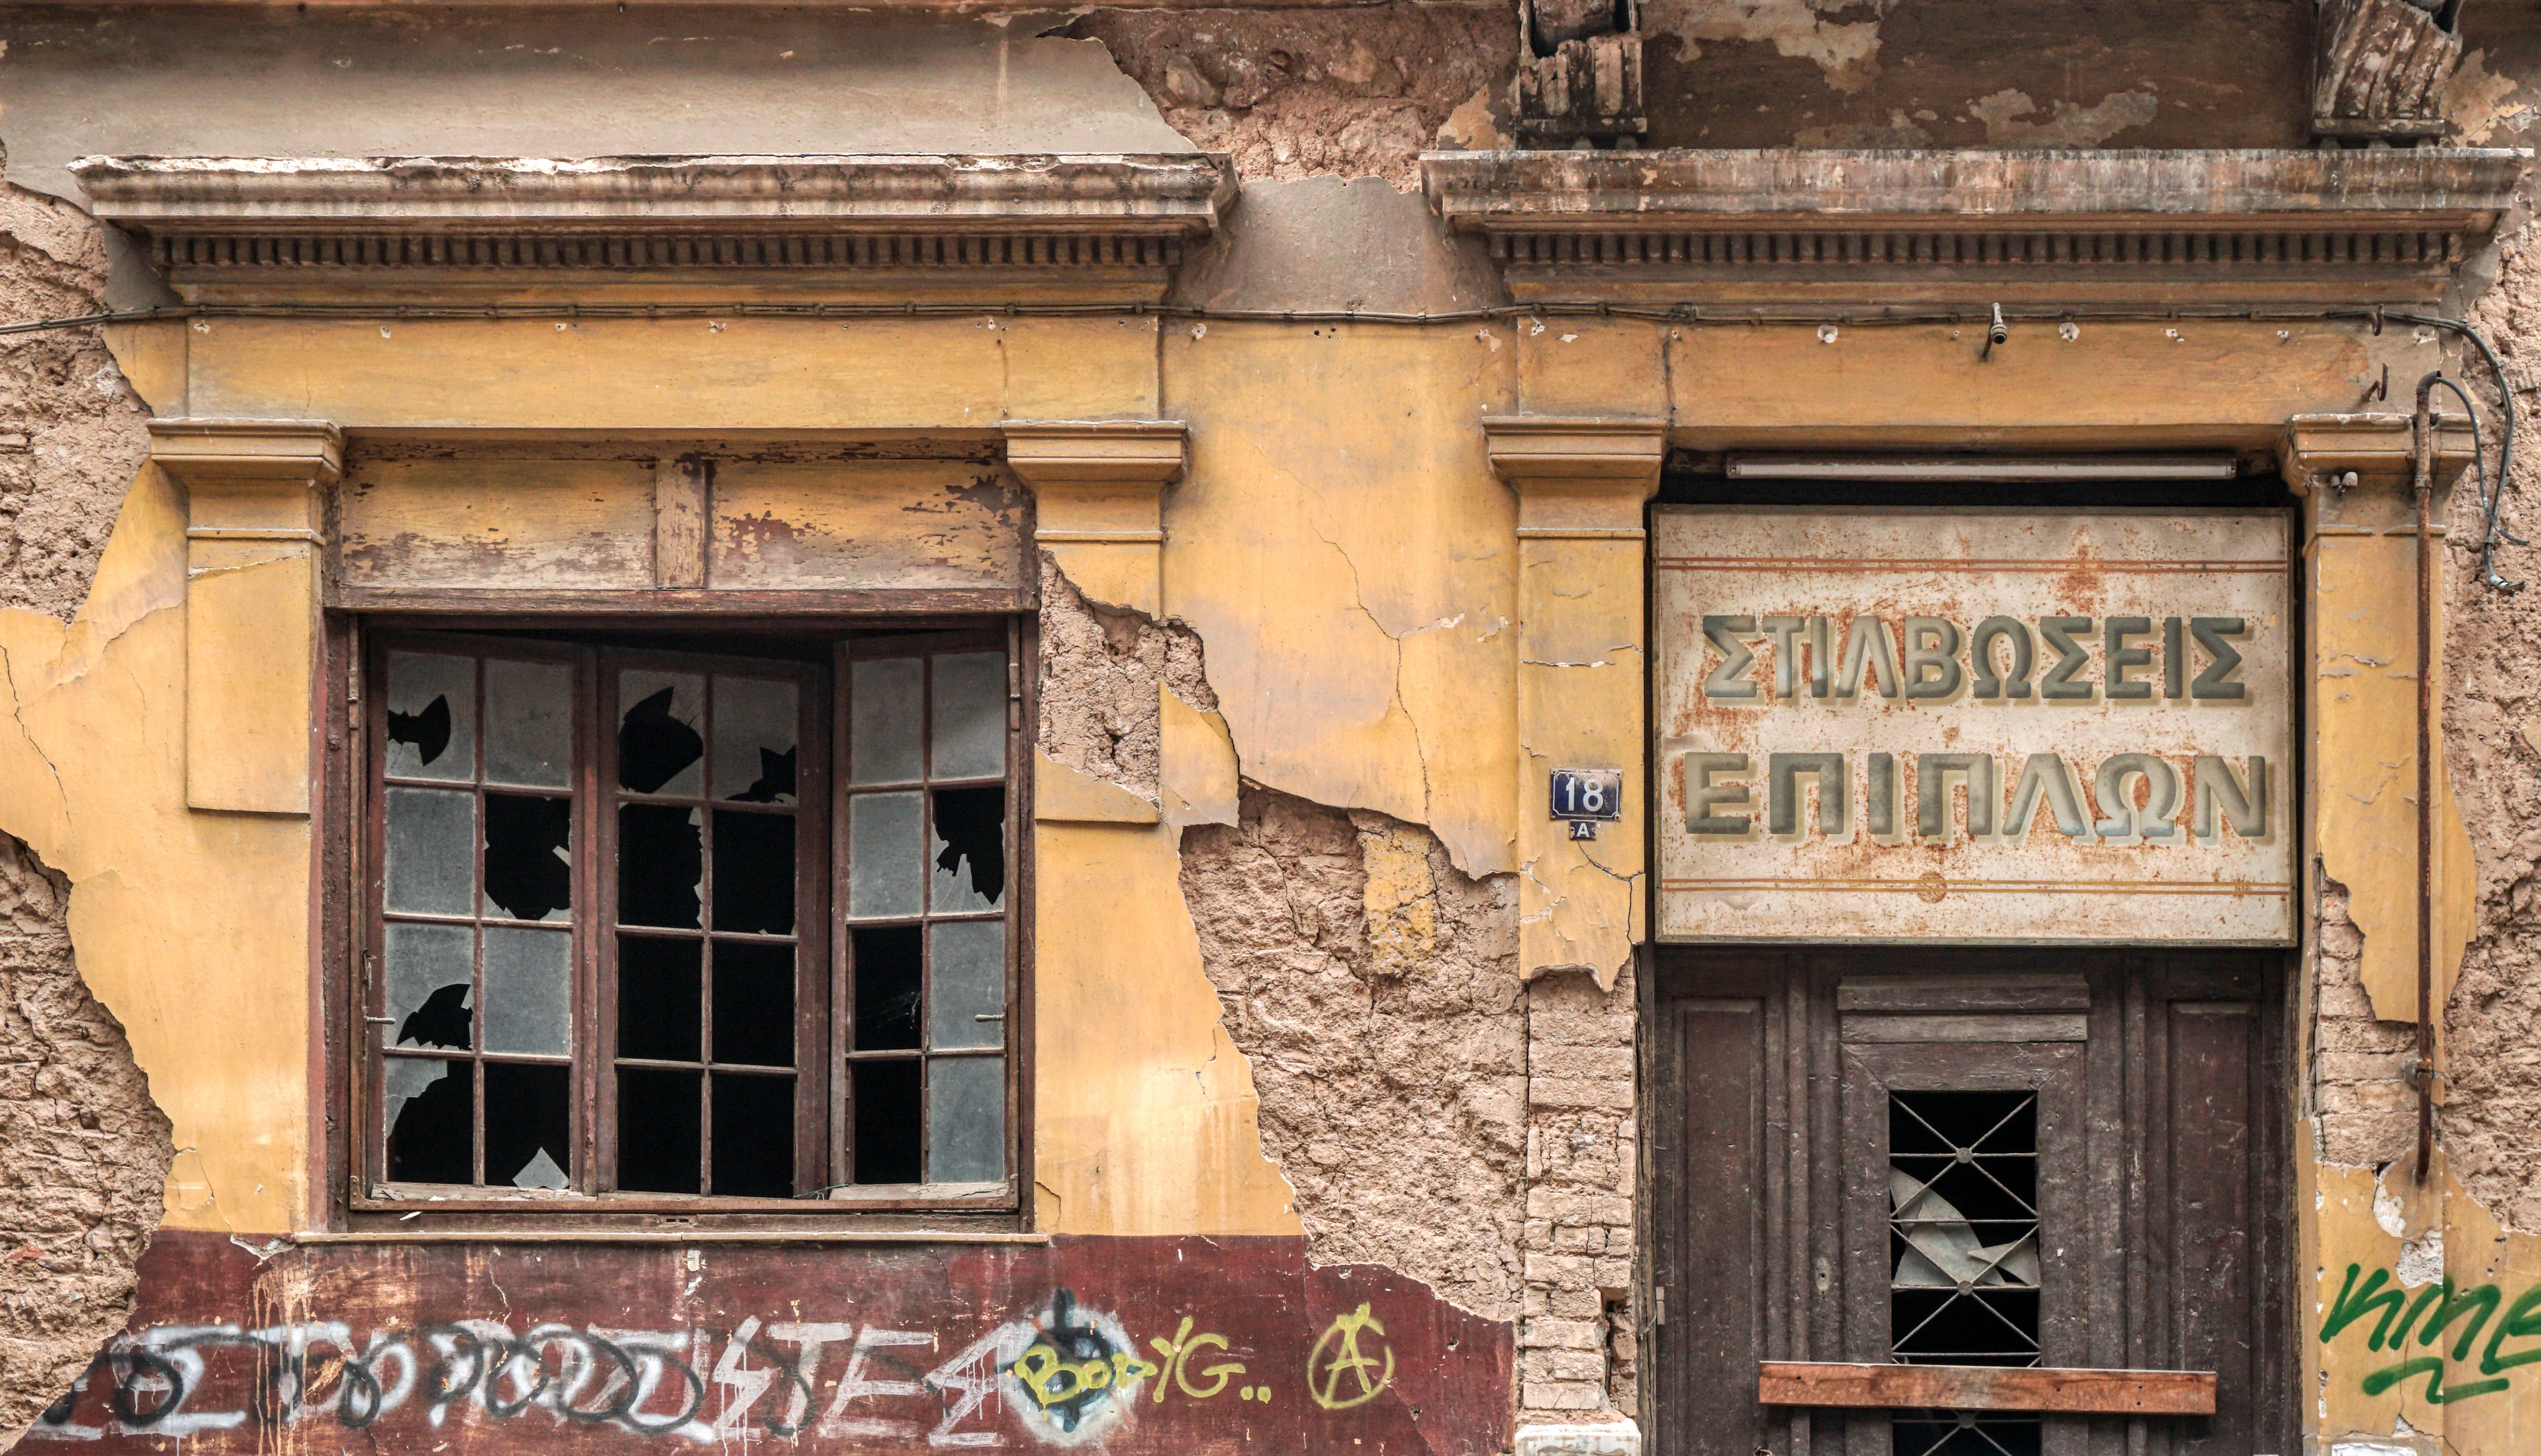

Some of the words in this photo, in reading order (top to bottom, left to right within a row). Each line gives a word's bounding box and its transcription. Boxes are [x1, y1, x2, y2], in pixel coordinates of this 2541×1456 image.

[1702, 615, 2246, 700] ΣΤΙΛΒΩΣΕΙΣ
[1565, 777, 1604, 812] 18
[1684, 752, 2267, 838] ΕΠΙΠΛΩΝ
